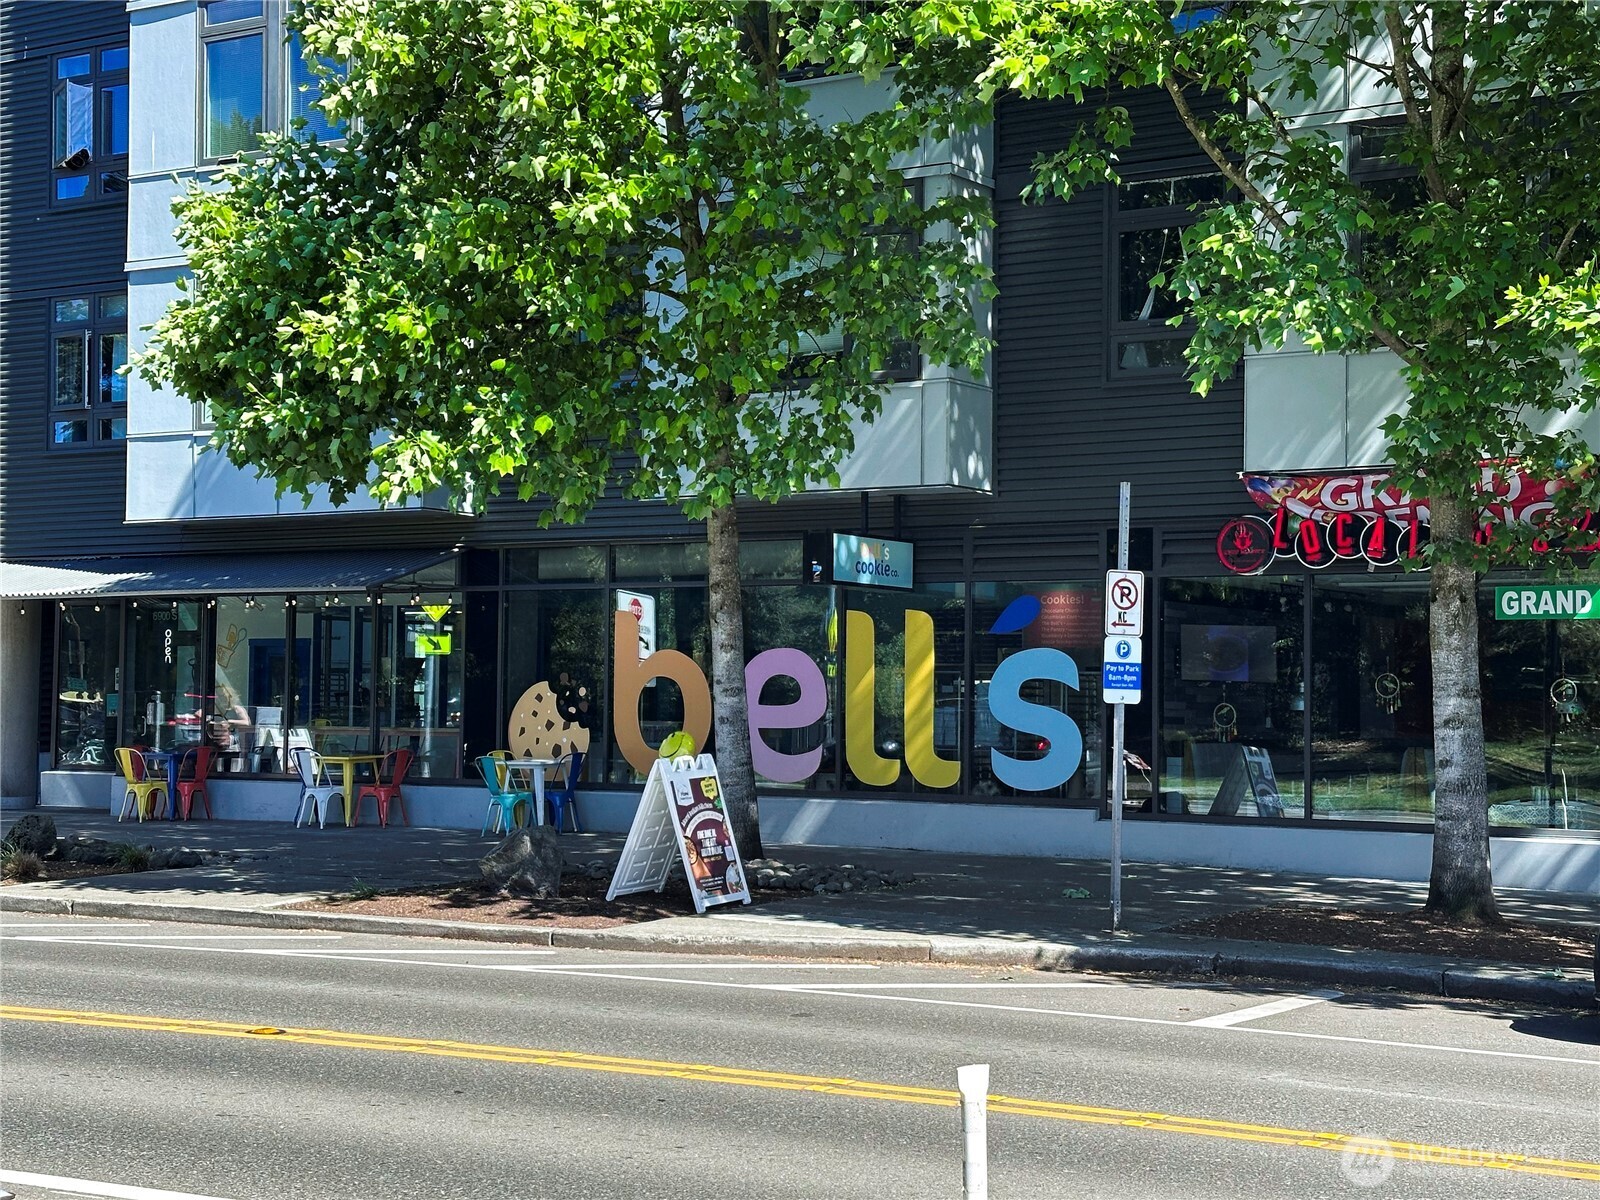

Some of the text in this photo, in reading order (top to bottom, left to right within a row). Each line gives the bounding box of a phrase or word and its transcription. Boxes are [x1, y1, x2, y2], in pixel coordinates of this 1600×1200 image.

[1320, 466, 1521, 512] GRD
[855, 560, 890, 577] cookie
[1040, 594, 1084, 605] Cookies!
[1501, 589, 1593, 616] GRAND
[164, 629, 172, 664] open
[1106, 664, 1117, 673] Pay
